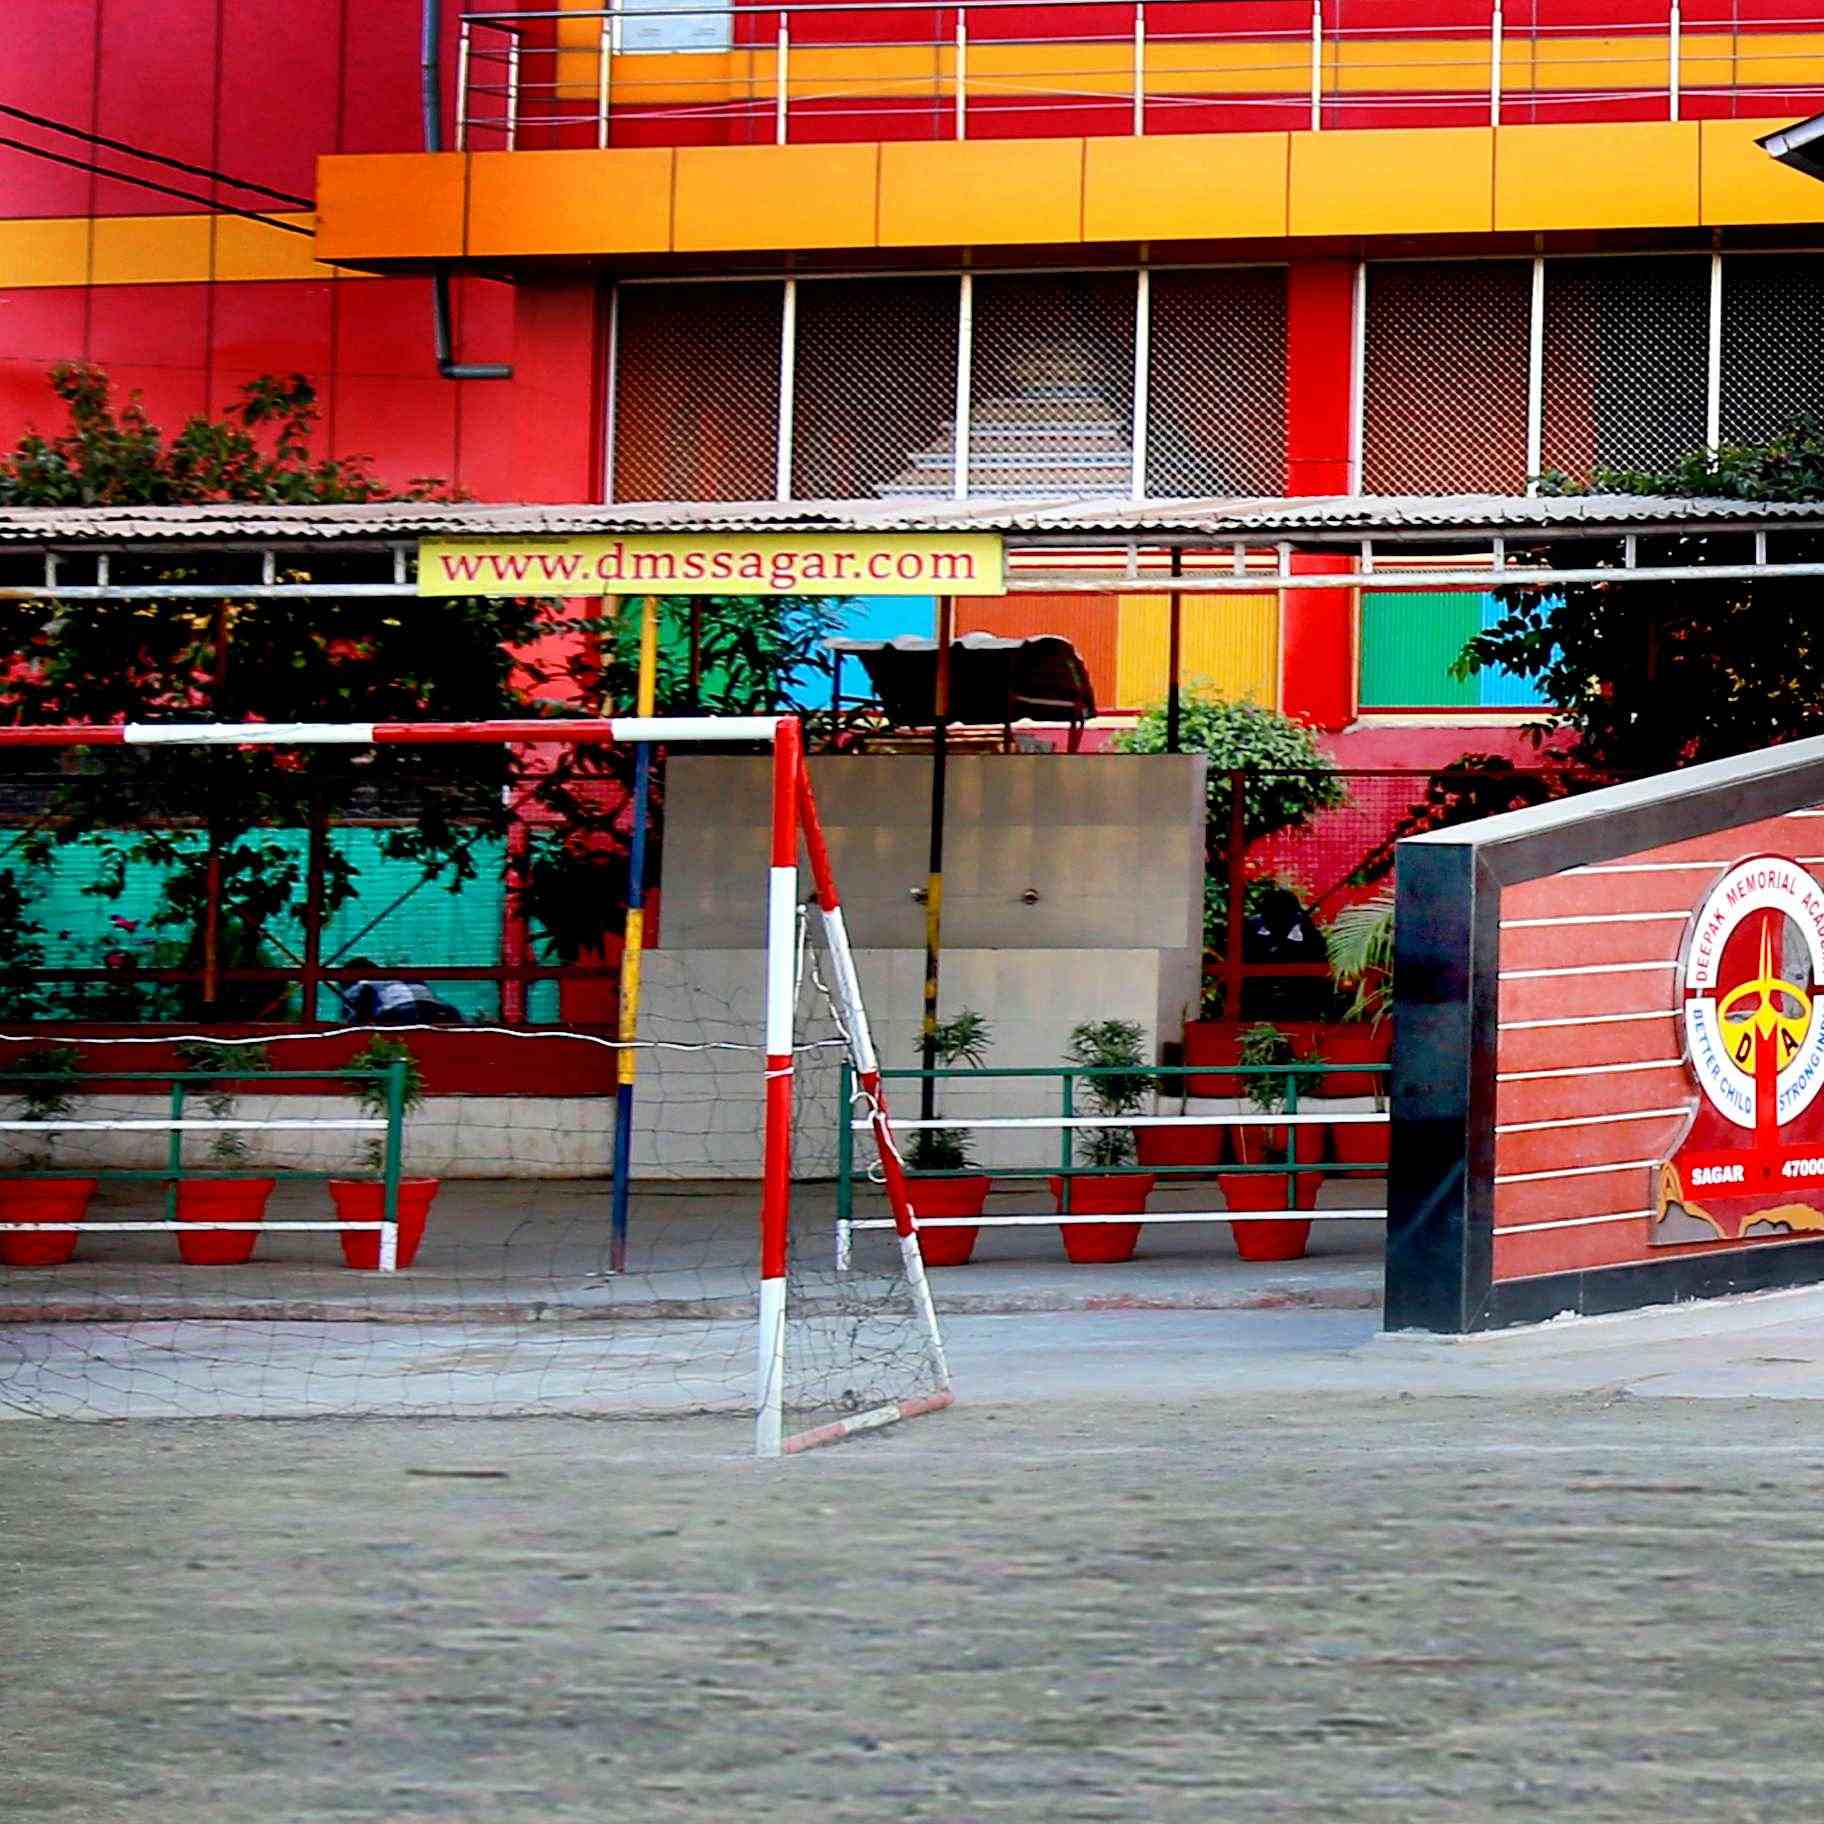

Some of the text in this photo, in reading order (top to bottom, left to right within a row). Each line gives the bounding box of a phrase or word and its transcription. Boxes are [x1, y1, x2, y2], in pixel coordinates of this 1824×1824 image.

[438, 542, 977, 589] www.dmssagar.com
[1696, 908, 1726, 982] DEEPAK
[1725, 870, 1797, 906] MEMORIAL
[1720, 1077, 1752, 1124] CHILD
[1778, 1053, 1821, 1112] STRONG
[1691, 1164, 1745, 1186] SAGAR
